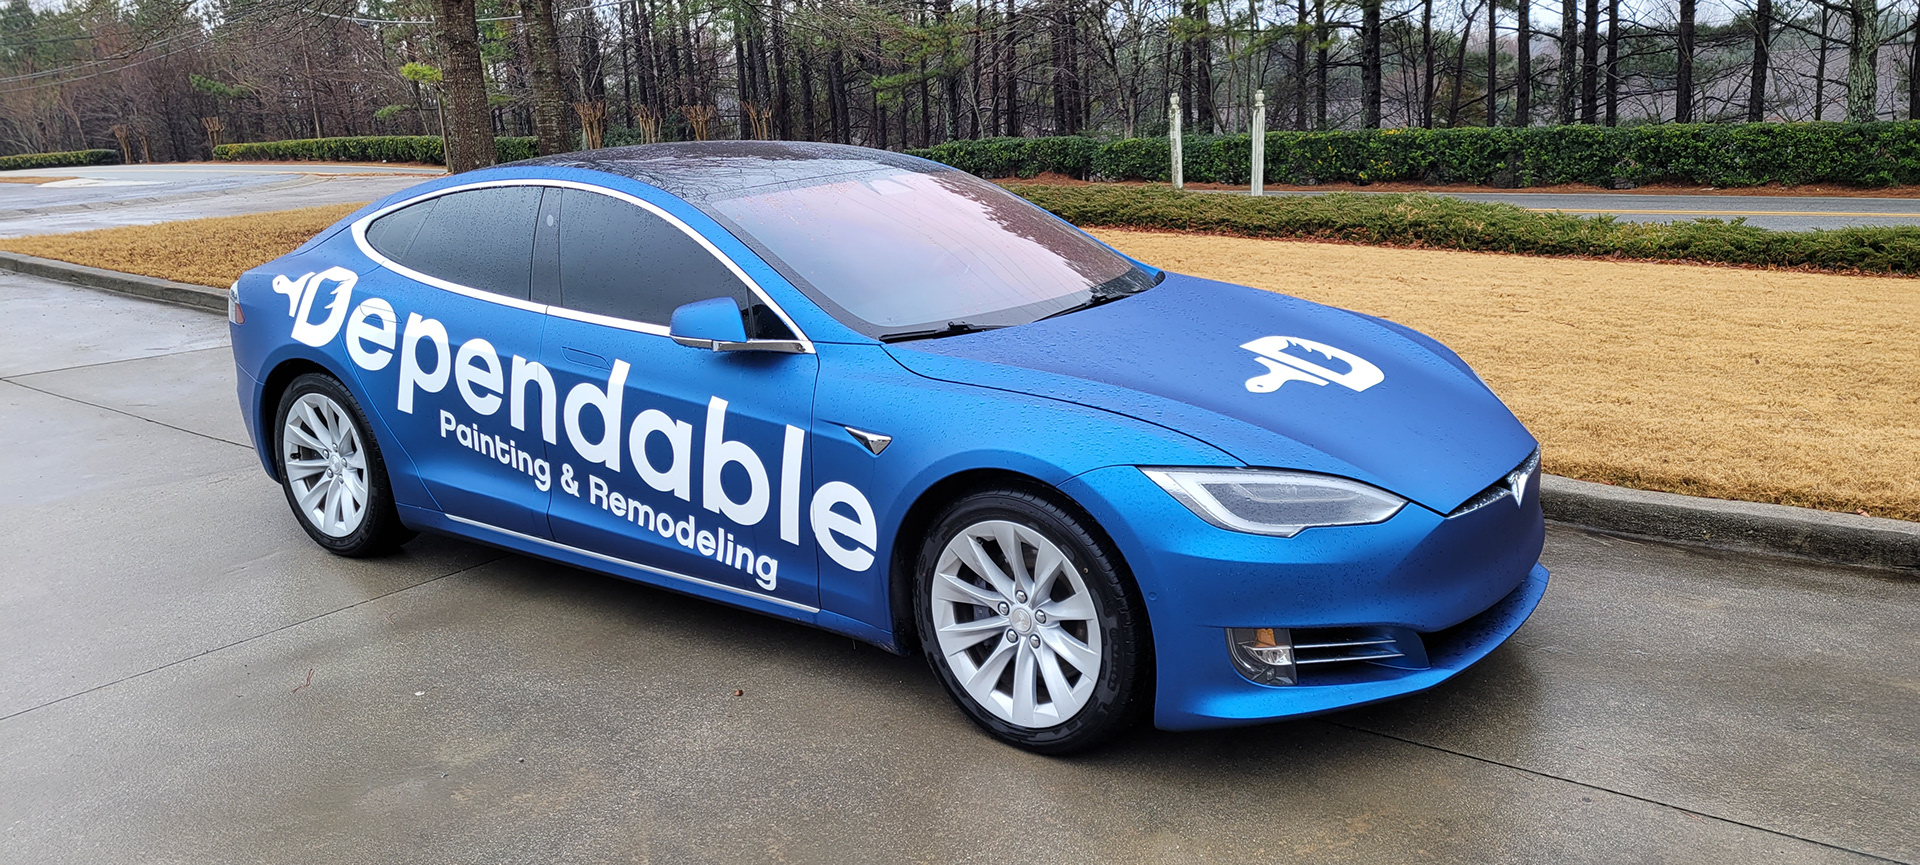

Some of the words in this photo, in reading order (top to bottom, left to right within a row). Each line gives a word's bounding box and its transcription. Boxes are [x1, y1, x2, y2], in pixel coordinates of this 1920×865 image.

[272, 266, 878, 572] Dependable
[440, 410, 551, 492] Painting
[561, 464, 580, 498] &
[589, 475, 778, 591] Remodeling
